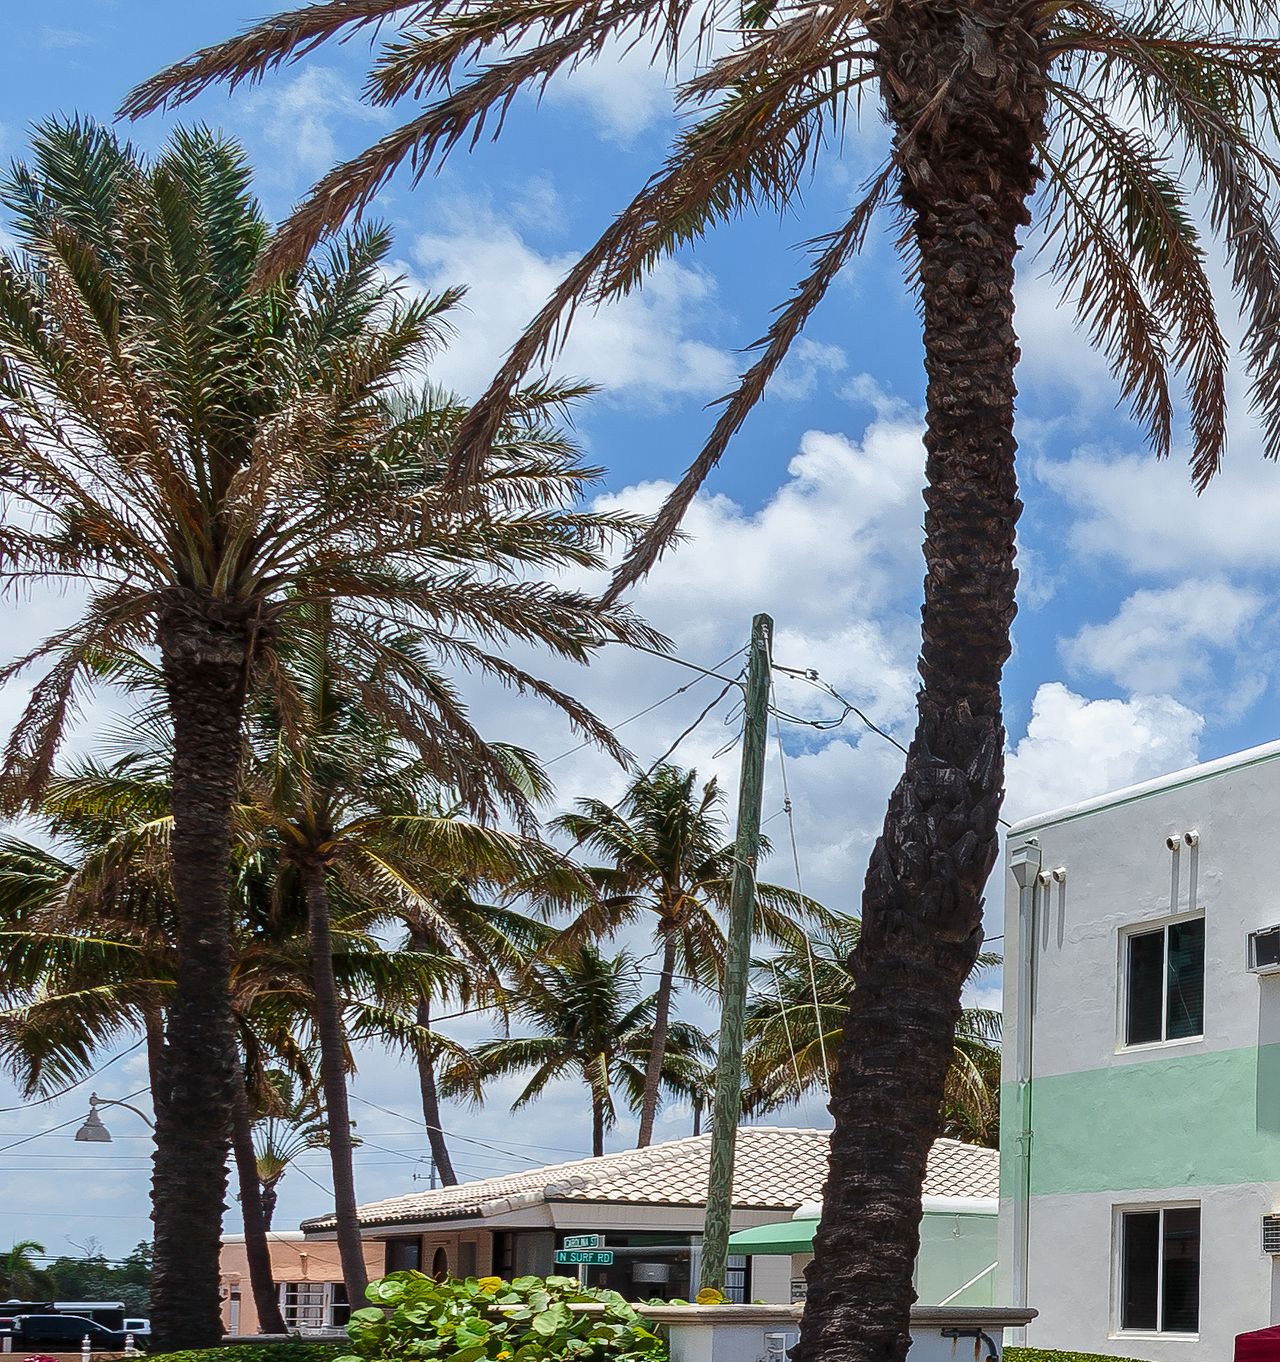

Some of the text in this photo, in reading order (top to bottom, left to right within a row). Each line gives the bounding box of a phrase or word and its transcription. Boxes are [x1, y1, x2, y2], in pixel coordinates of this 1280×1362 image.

[560, 1252, 610, 1263] N SURF RD
